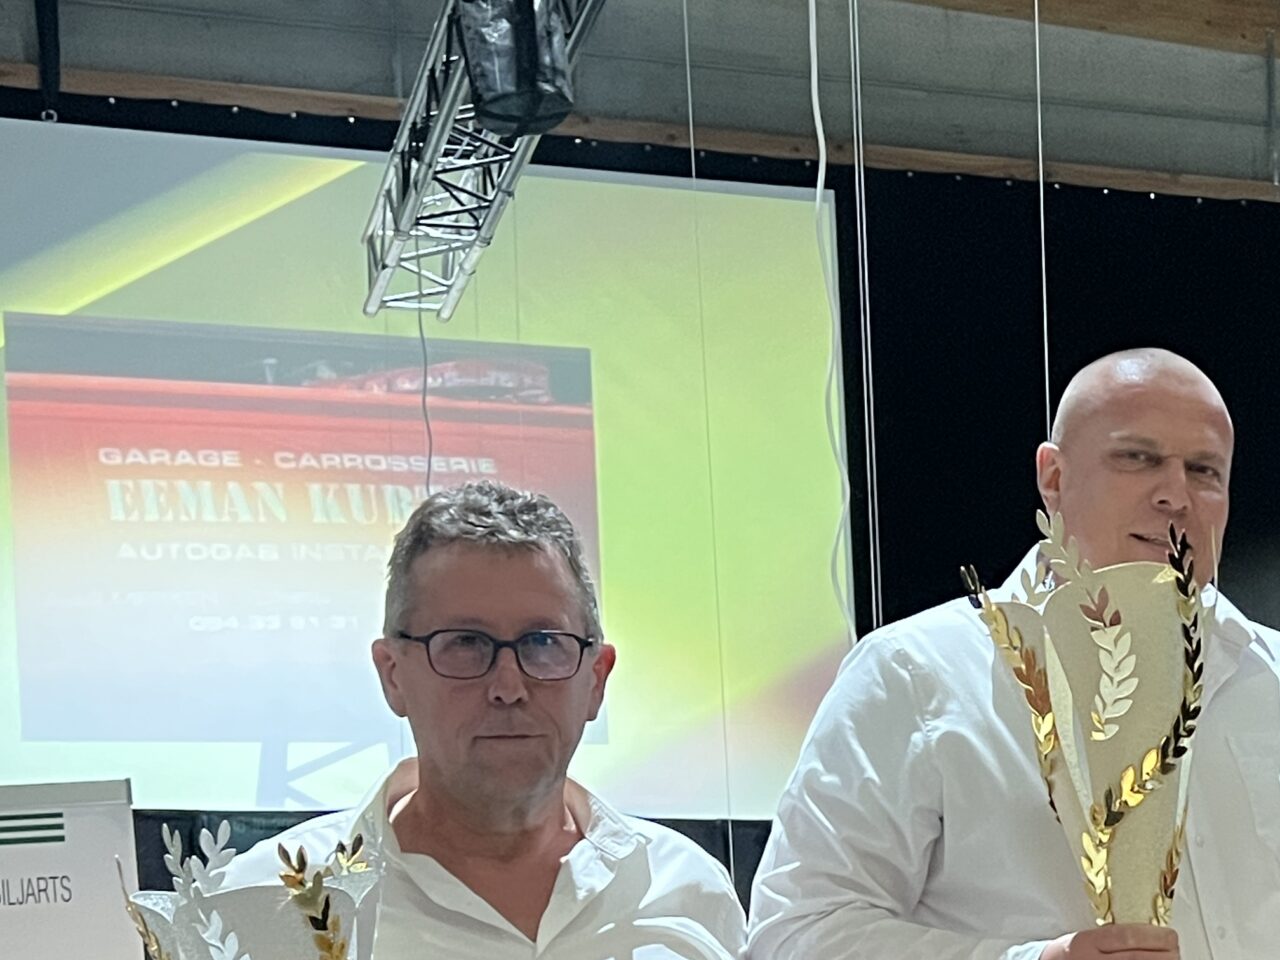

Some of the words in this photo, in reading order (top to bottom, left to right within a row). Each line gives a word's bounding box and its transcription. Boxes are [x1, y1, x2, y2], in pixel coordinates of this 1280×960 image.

[98, 448, 242, 469] GARAGE
[273, 451, 497, 474] CARROSSERIE
[106, 479, 287, 523] EEMAN
[0, 875, 73, 906] ILJARTS
